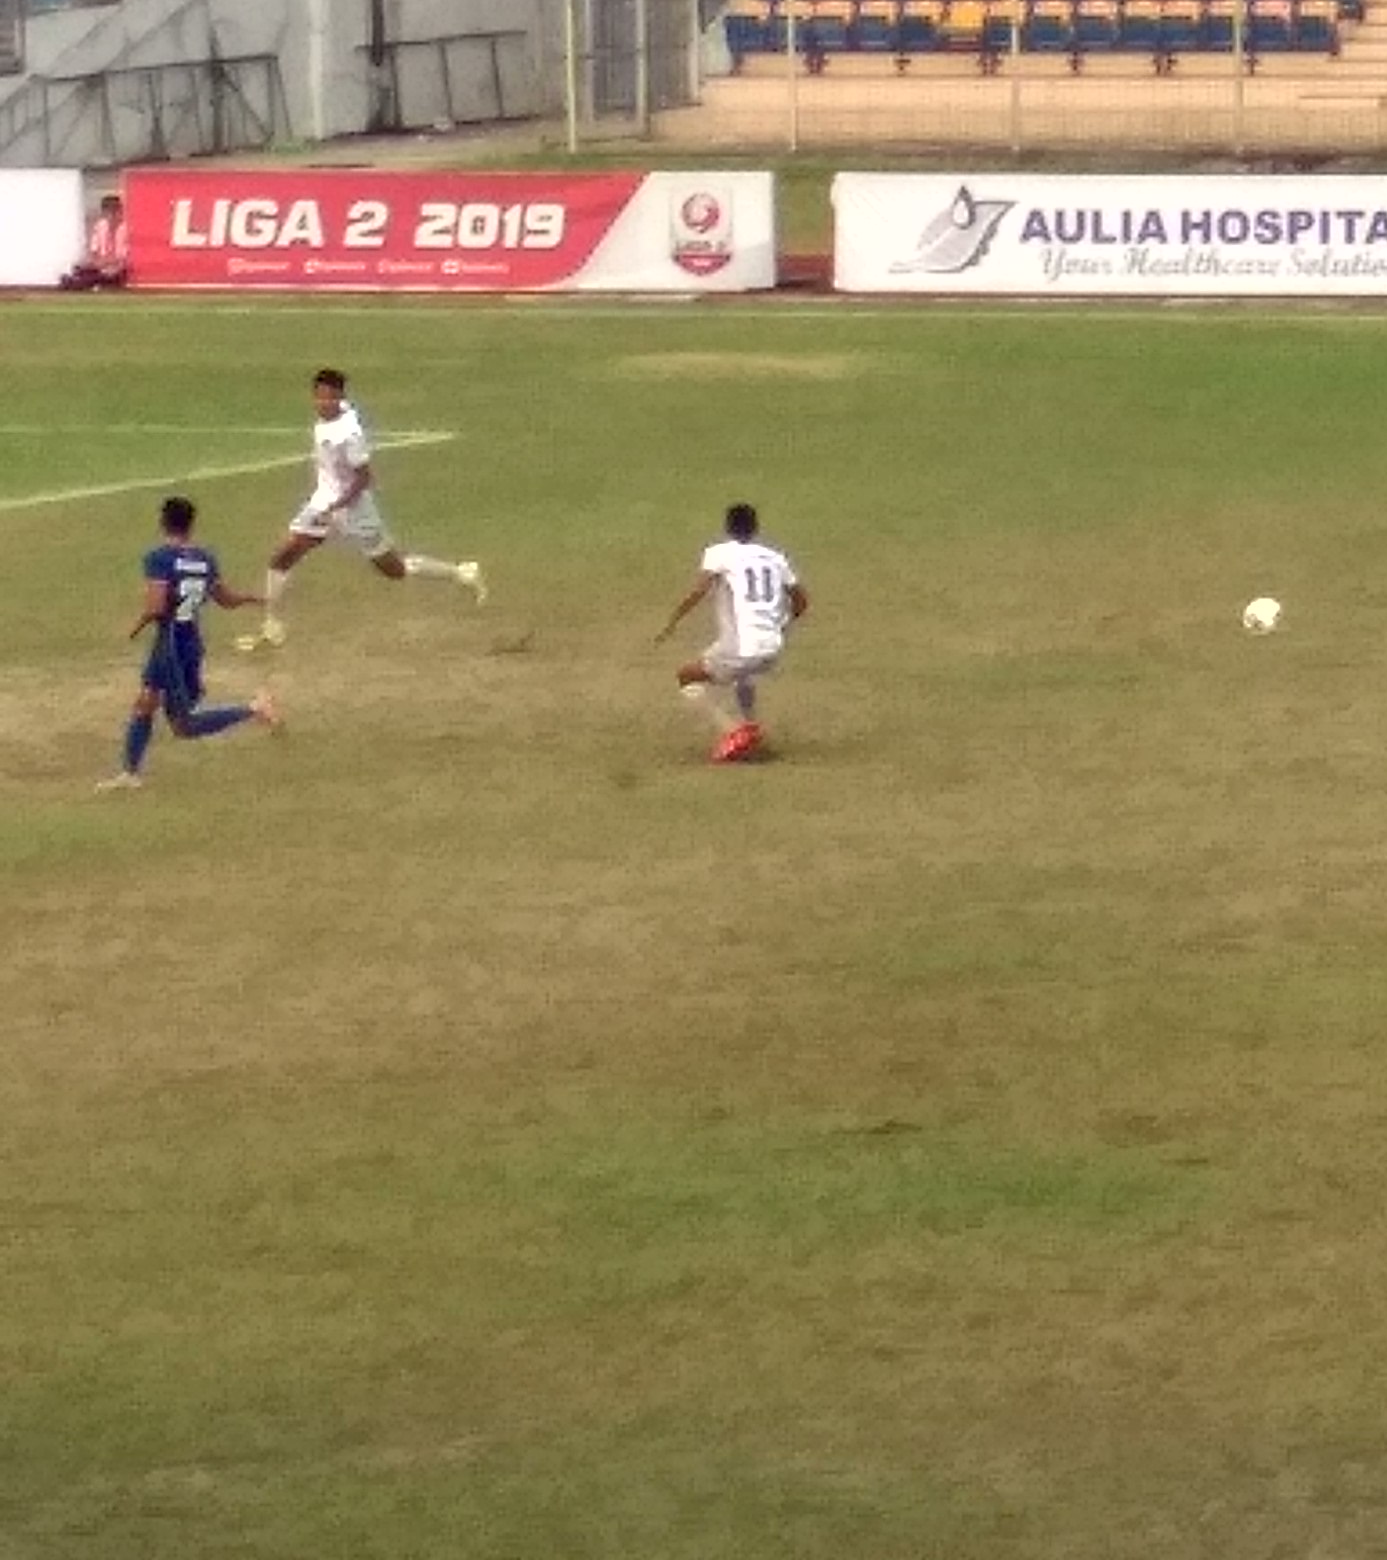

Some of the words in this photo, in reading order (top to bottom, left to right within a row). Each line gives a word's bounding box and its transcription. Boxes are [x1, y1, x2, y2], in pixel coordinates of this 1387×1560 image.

[170, 199, 324, 247] LIGA
[343, 199, 388, 248] 2
[413, 202, 565, 248] 2019
[1020, 209, 1167, 244] AULIA
[1040, 247, 1113, 283] Your
[1120, 247, 1281, 277] Healthcare
[744, 567, 772, 602] 11
